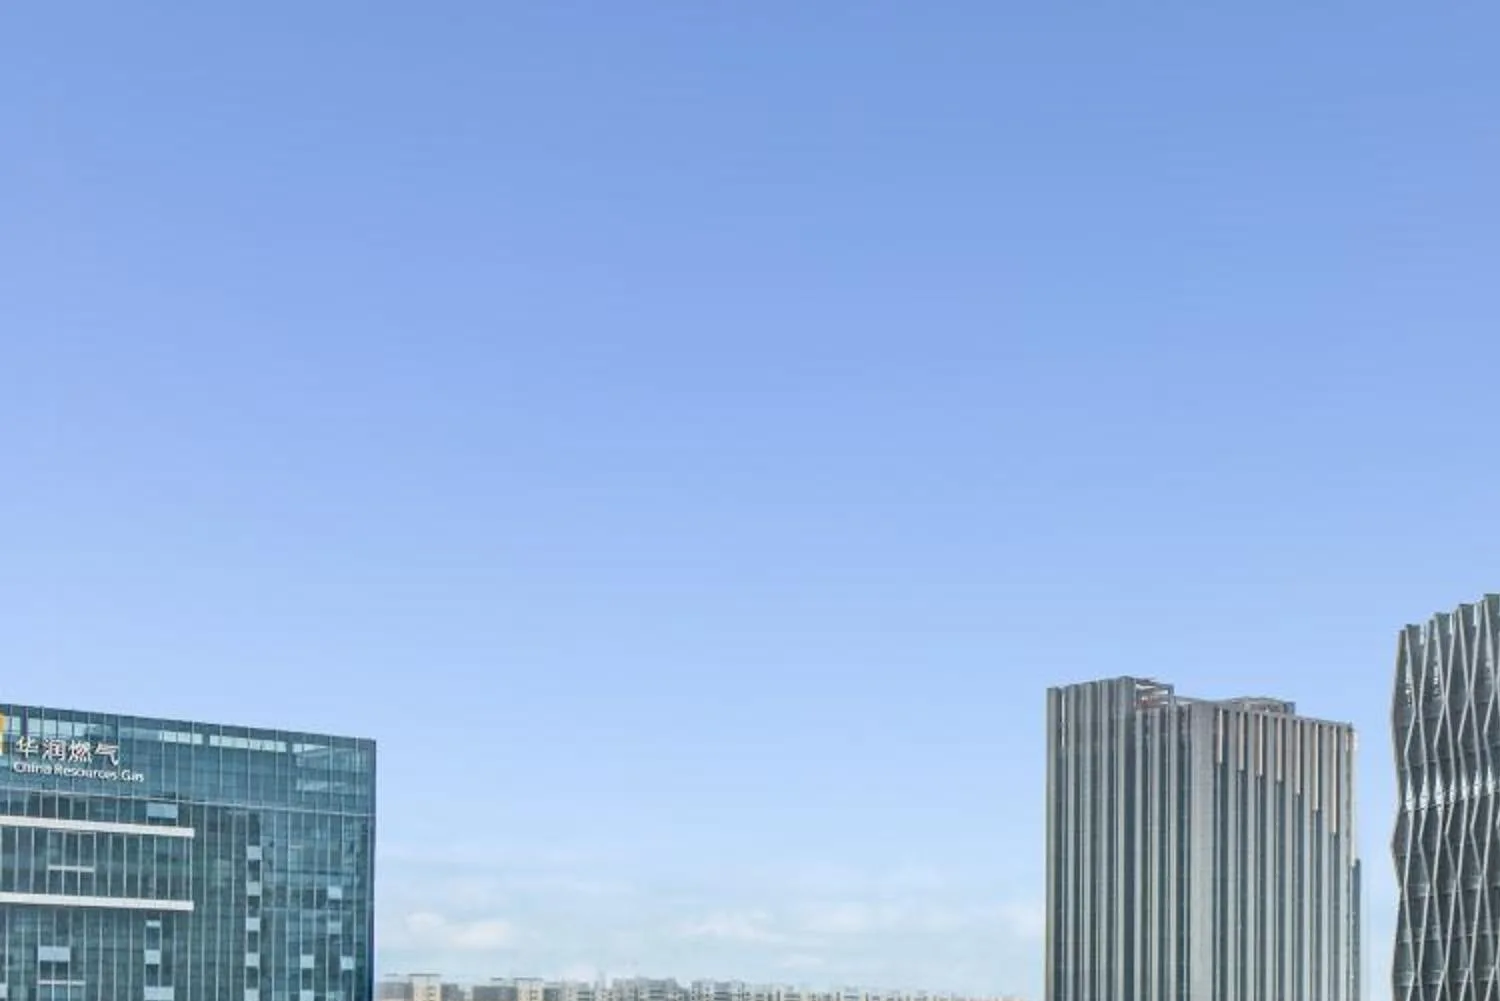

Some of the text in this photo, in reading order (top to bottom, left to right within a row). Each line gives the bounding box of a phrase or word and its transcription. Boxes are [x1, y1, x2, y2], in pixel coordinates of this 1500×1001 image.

[15, 736, 119, 767] 华润燃气
[13, 761, 145, 783] China Resources Gas
